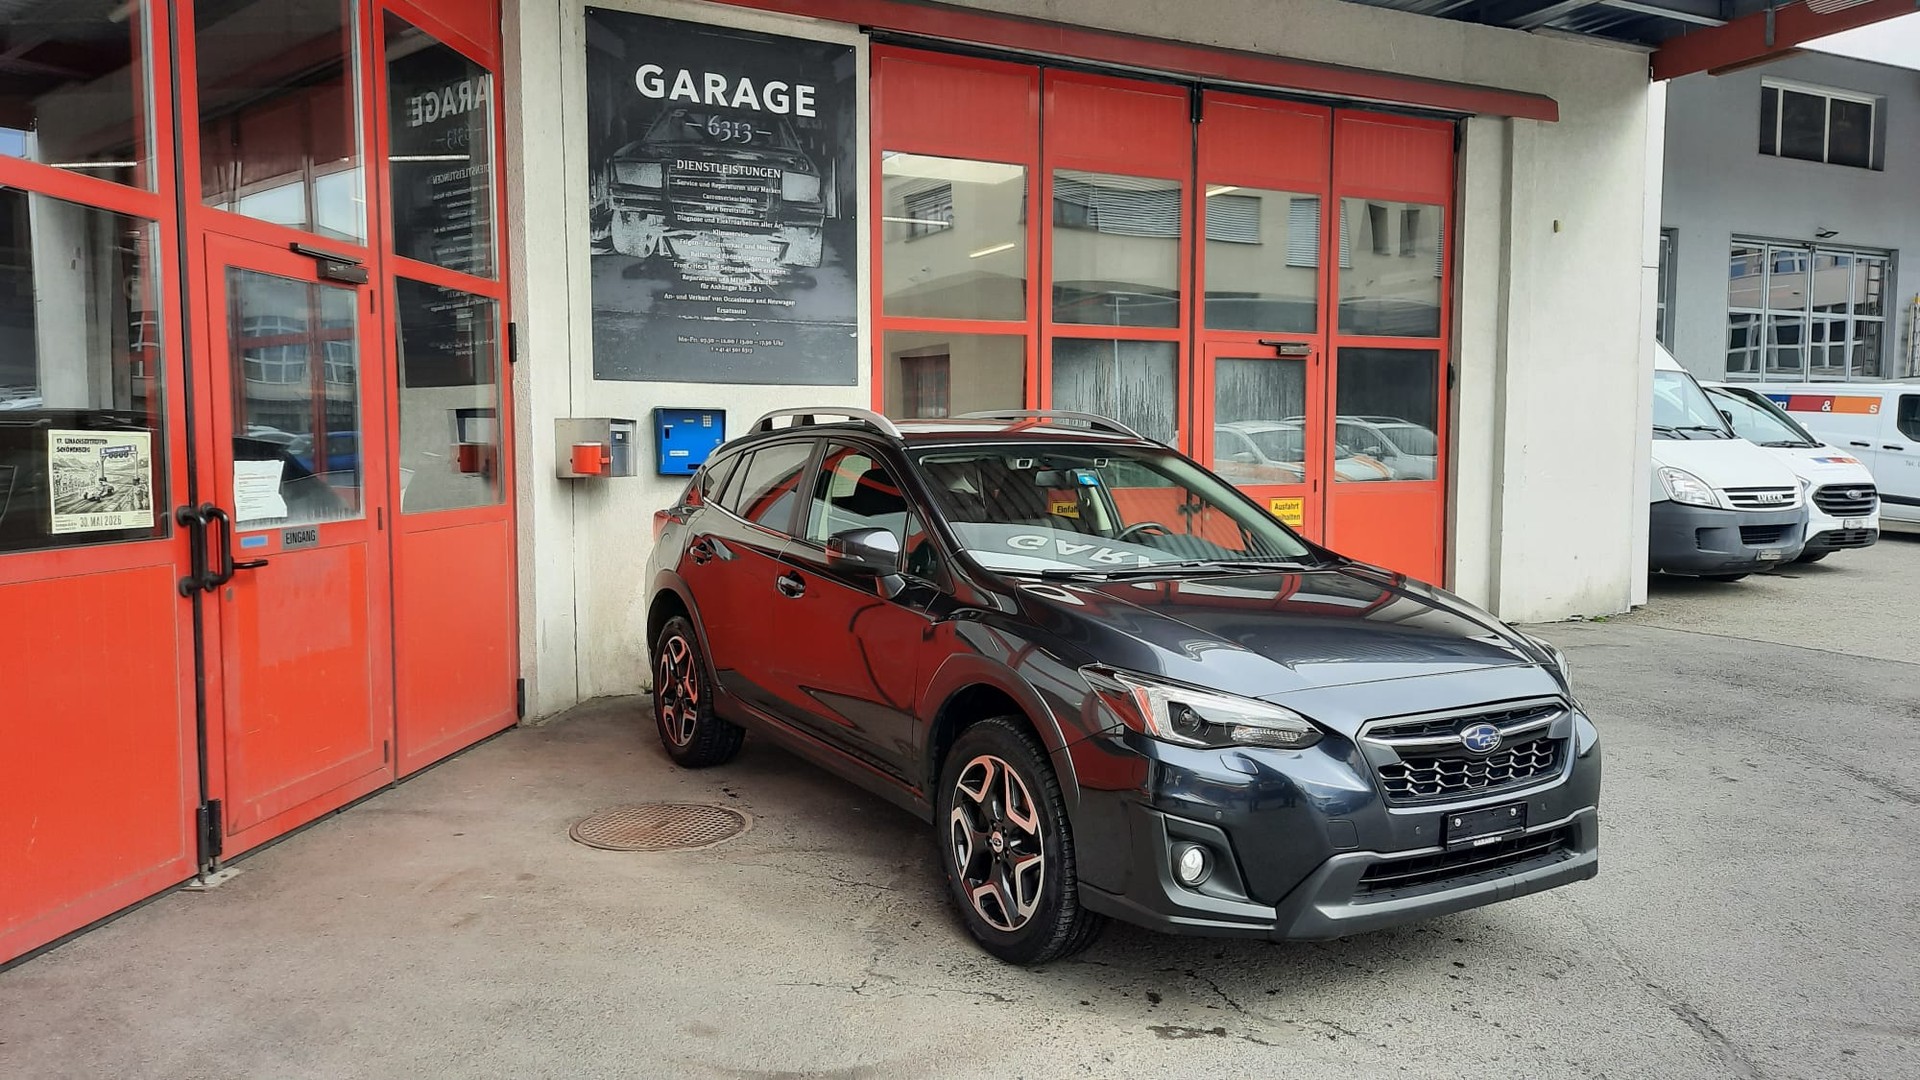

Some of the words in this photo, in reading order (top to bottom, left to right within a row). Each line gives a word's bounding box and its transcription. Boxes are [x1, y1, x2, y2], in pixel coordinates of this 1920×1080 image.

[635, 63, 816, 117] GARAGE
[707, 114, 752, 144] 6313
[676, 159, 781, 178] DIENSTLEISTUNGEN
[677, 214, 703, 223] Diagnose
[760, 220, 773, 228] aller
[700, 282, 709, 290] für
[663, 292, 675, 300] An-
[688, 294, 711, 302] Verkauf
[767, 298, 796, 307] Neuwagen
[1821, 400, 1831, 412] &
[1274, 502, 1300, 510] Ausfahrt
[285, 529, 316, 545] EINGANG
